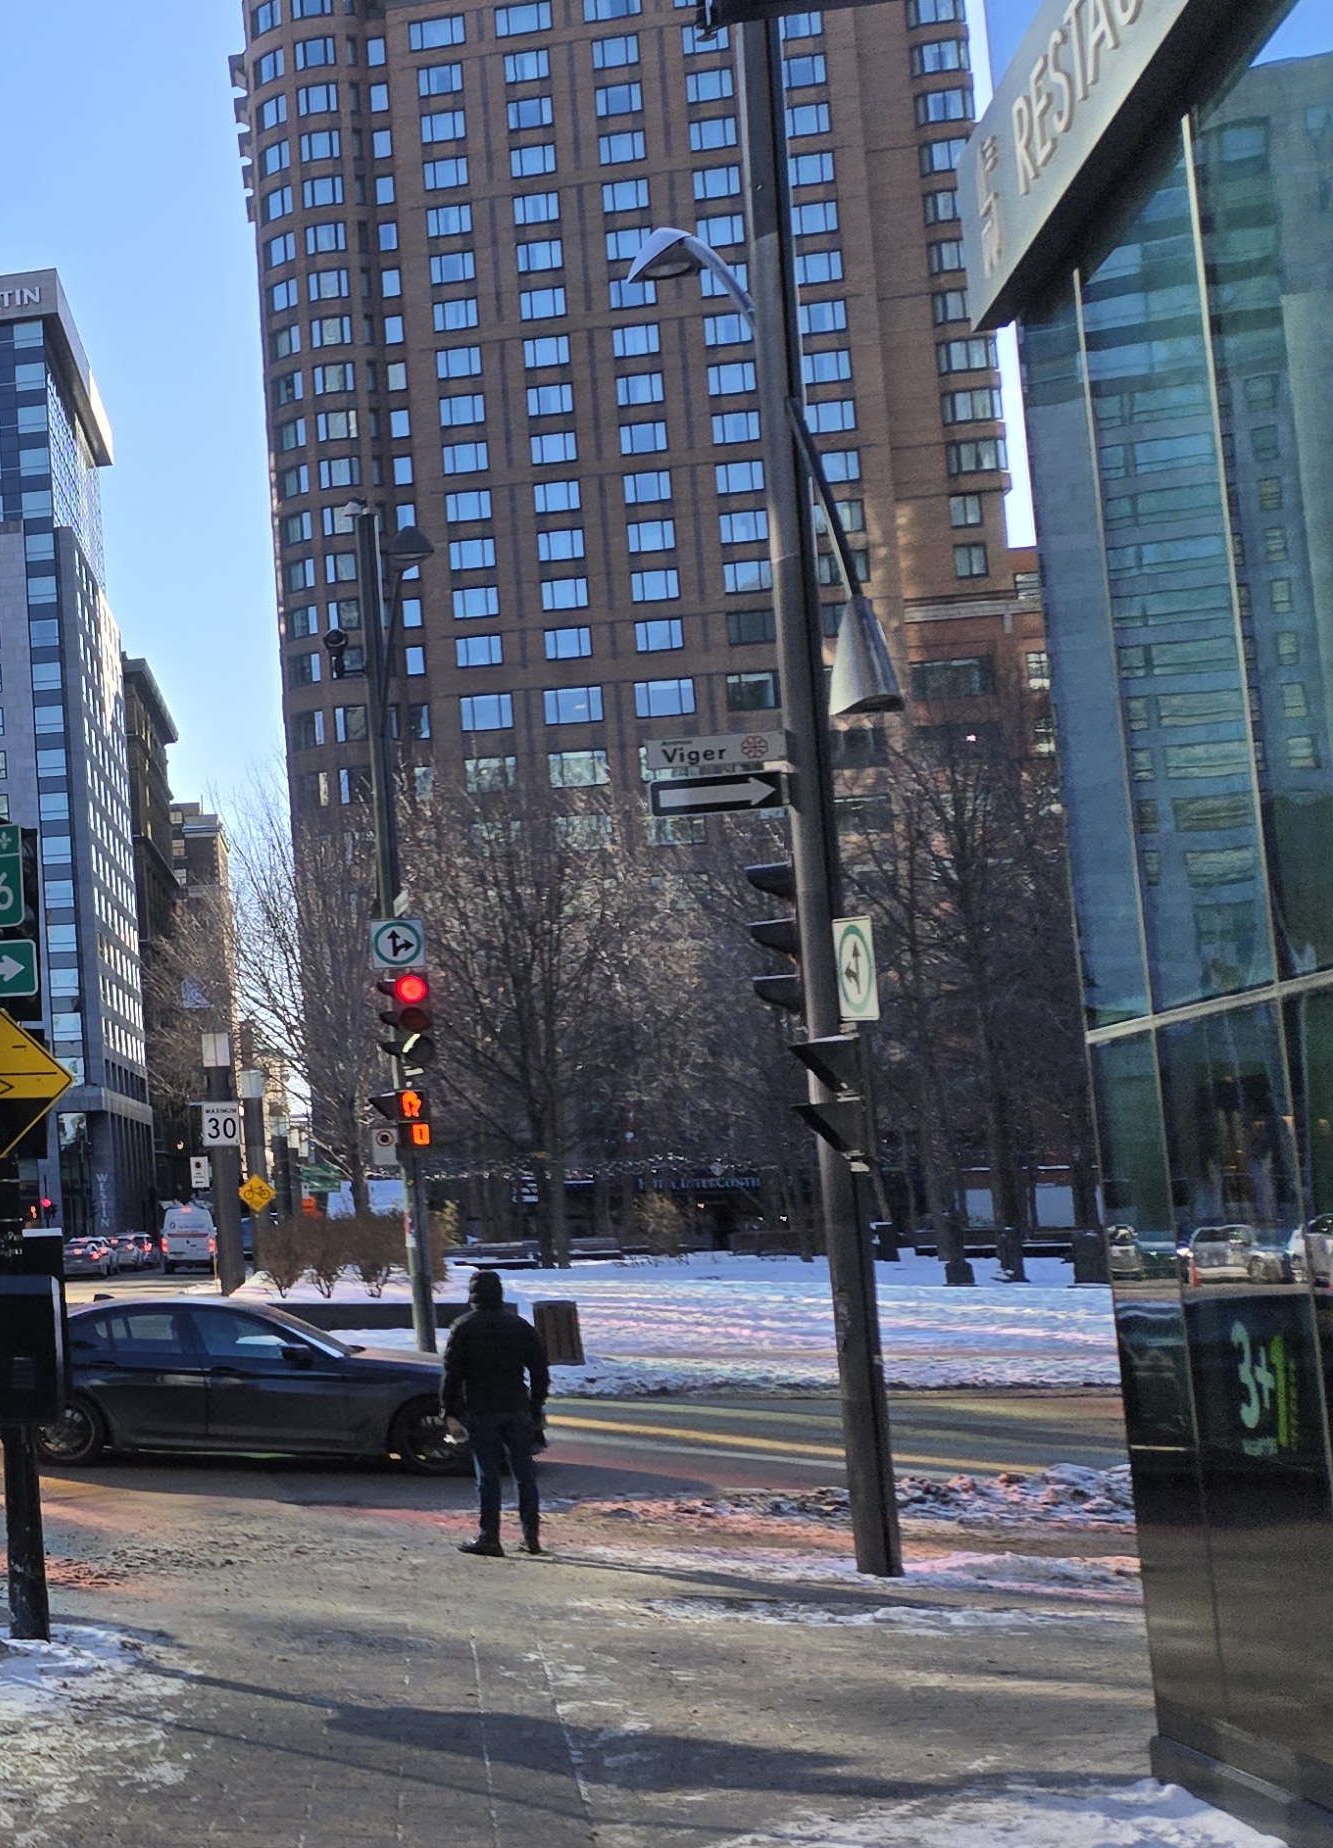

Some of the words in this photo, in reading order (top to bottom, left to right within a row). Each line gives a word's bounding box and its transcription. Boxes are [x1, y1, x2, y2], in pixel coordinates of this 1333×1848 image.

[661, 747, 727, 766] Viger
[207, 1117, 237, 1139] 30
[95, 1173, 111, 1228] WESTIN
